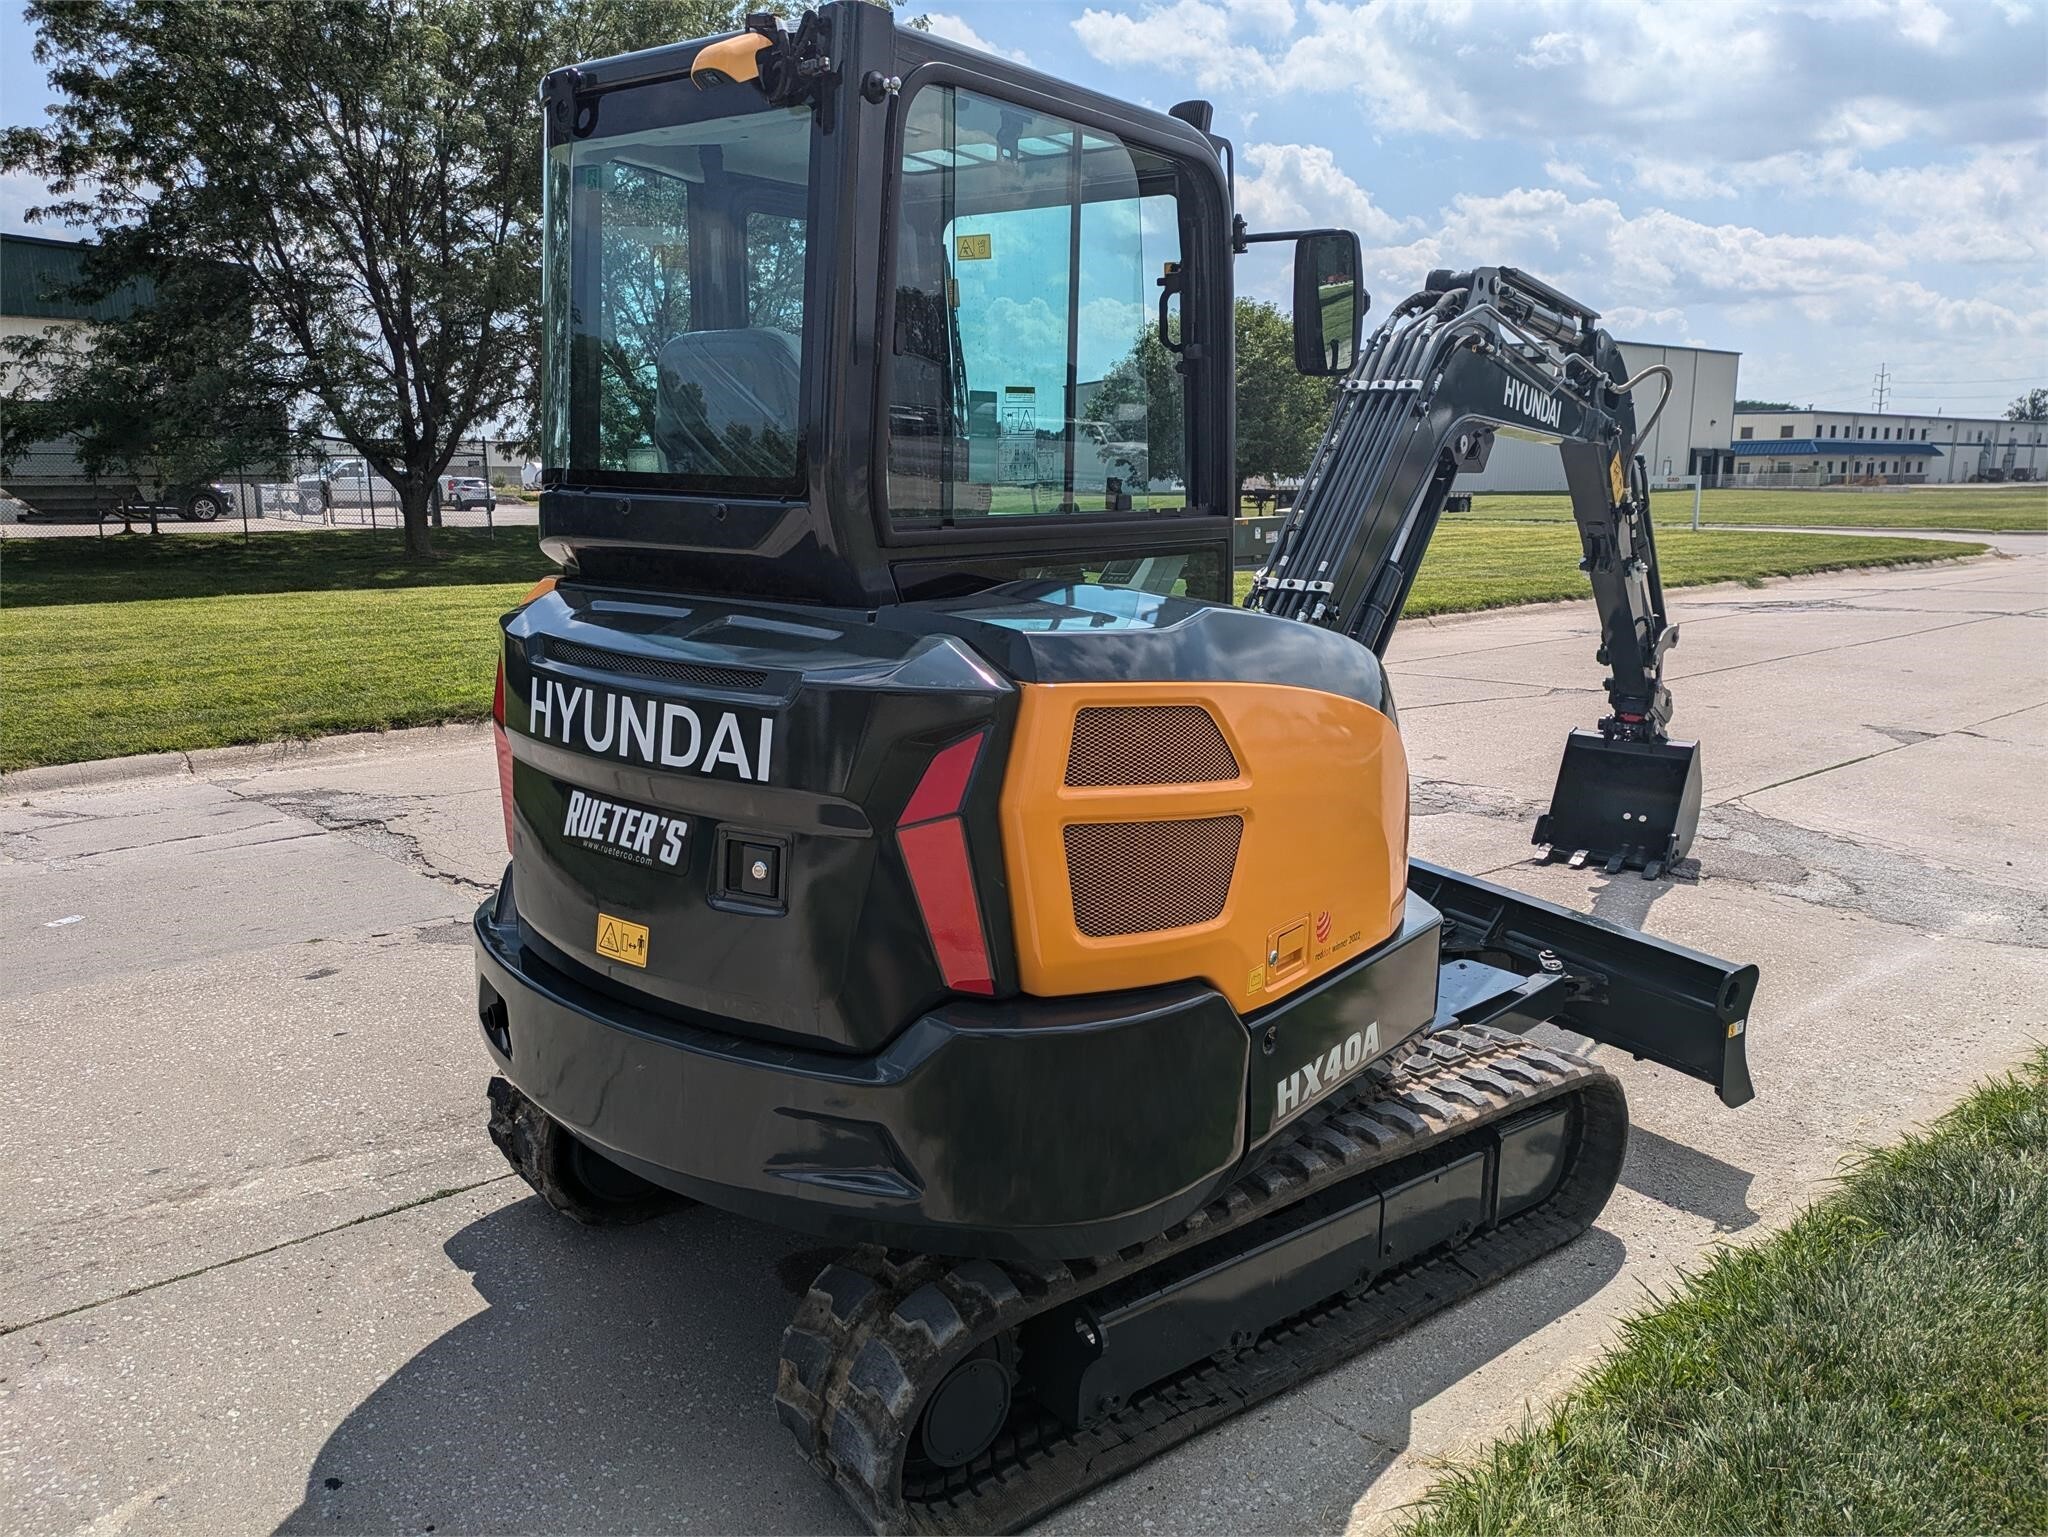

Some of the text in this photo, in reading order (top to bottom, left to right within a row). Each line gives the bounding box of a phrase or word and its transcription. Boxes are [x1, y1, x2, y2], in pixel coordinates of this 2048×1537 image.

[1504, 376, 1562, 428] HYUNDAI
[529, 675, 774, 782] HYUNDAI
[563, 790, 688, 866] RUETER'S
[582, 840, 653, 866] www.rueterco.com
[1276, 1020, 1381, 1119] HX40A
